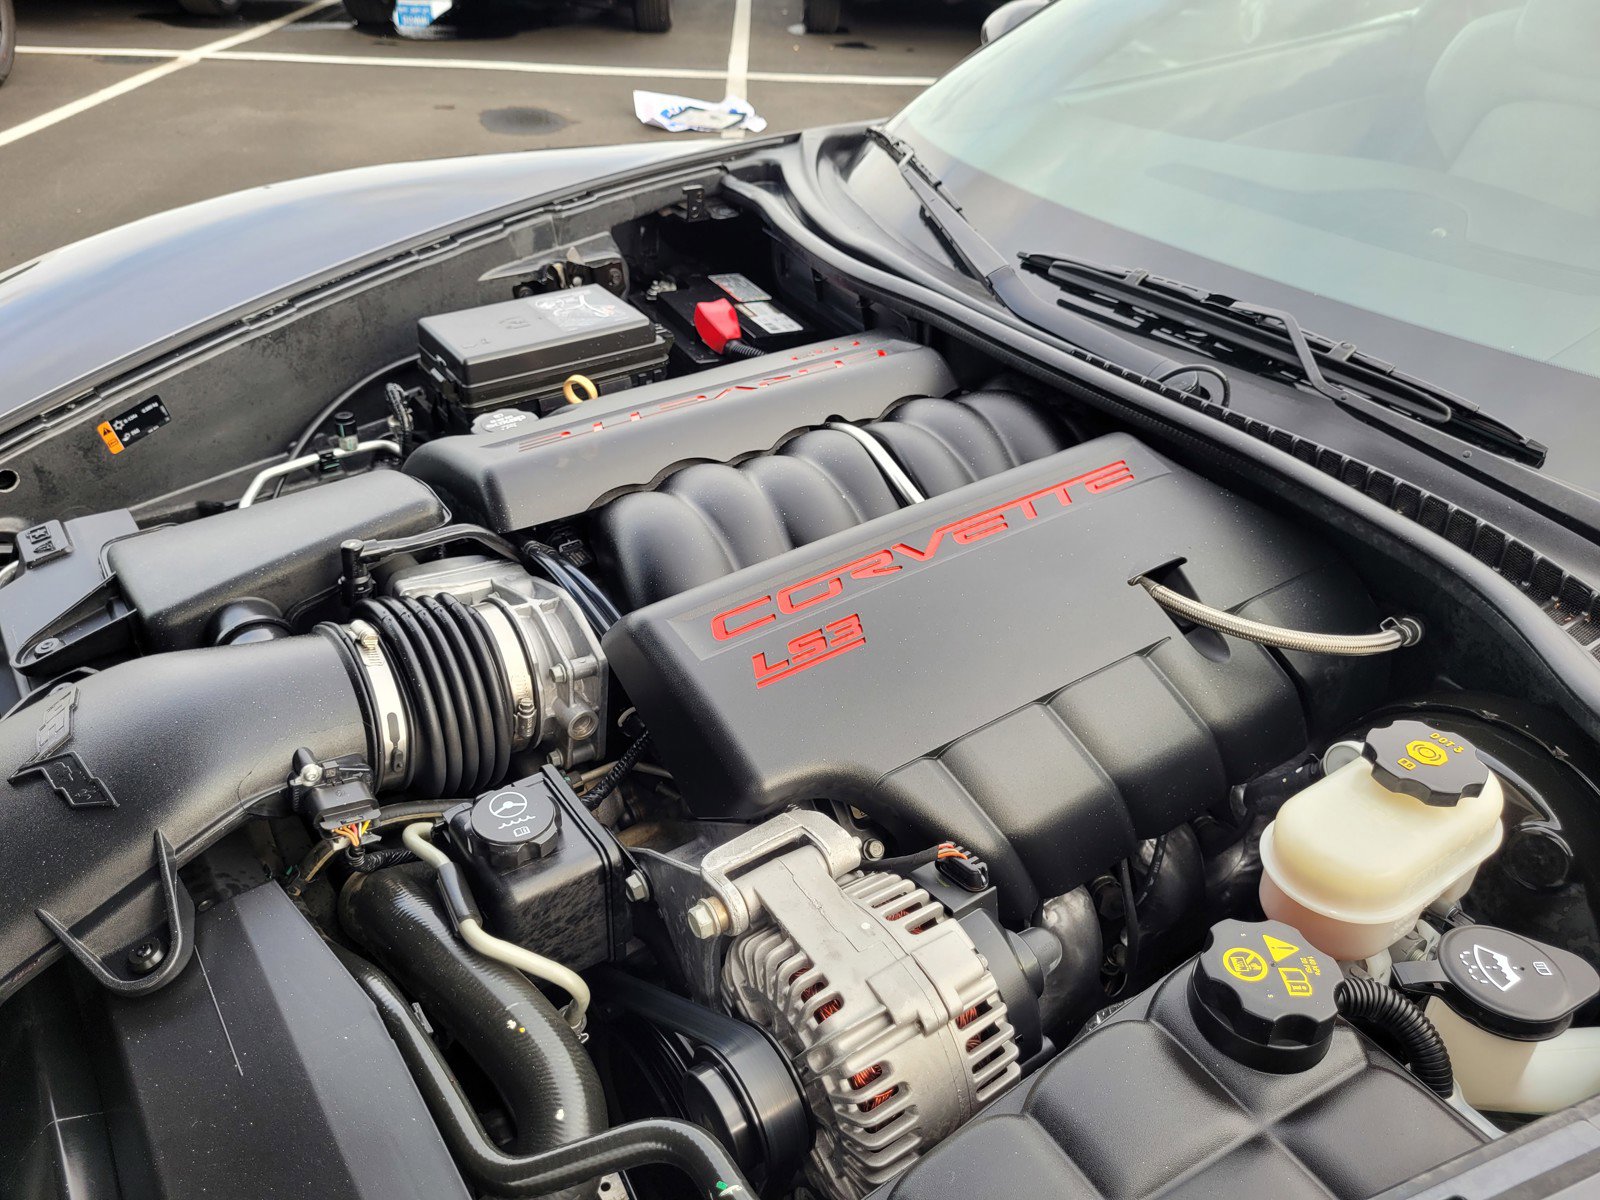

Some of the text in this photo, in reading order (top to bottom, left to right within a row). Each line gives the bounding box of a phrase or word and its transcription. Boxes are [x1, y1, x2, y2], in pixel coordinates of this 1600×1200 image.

[710, 459, 1135, 641] CORVETTE
[751, 613, 865, 681] LS3
[1429, 732, 1455, 747] DOT
